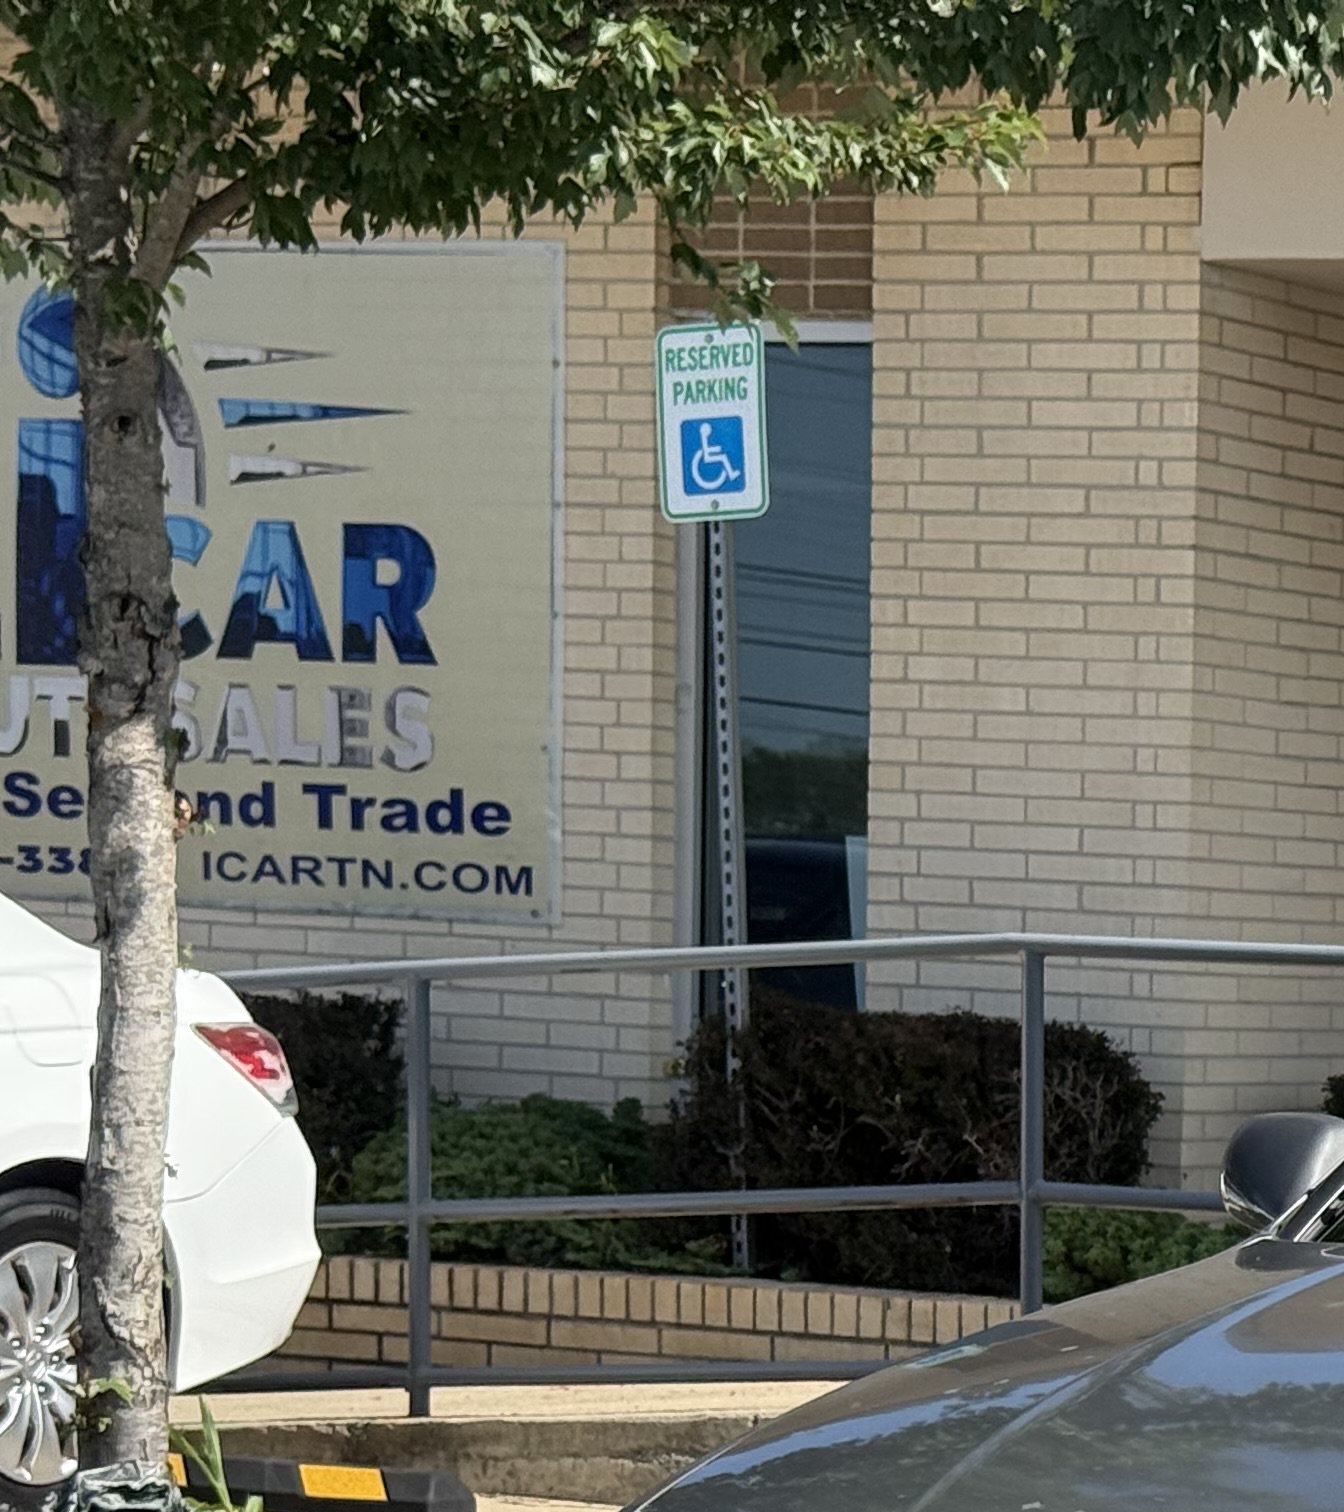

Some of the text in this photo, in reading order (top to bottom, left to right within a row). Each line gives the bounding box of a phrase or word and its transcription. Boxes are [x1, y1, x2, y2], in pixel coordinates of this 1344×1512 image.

[664, 342, 754, 374] RESERVED
[672, 376, 748, 406] PARKING
[3, 771, 512, 838] Se nd Trade
[203, 850, 534, 897] ICARTN.COM
